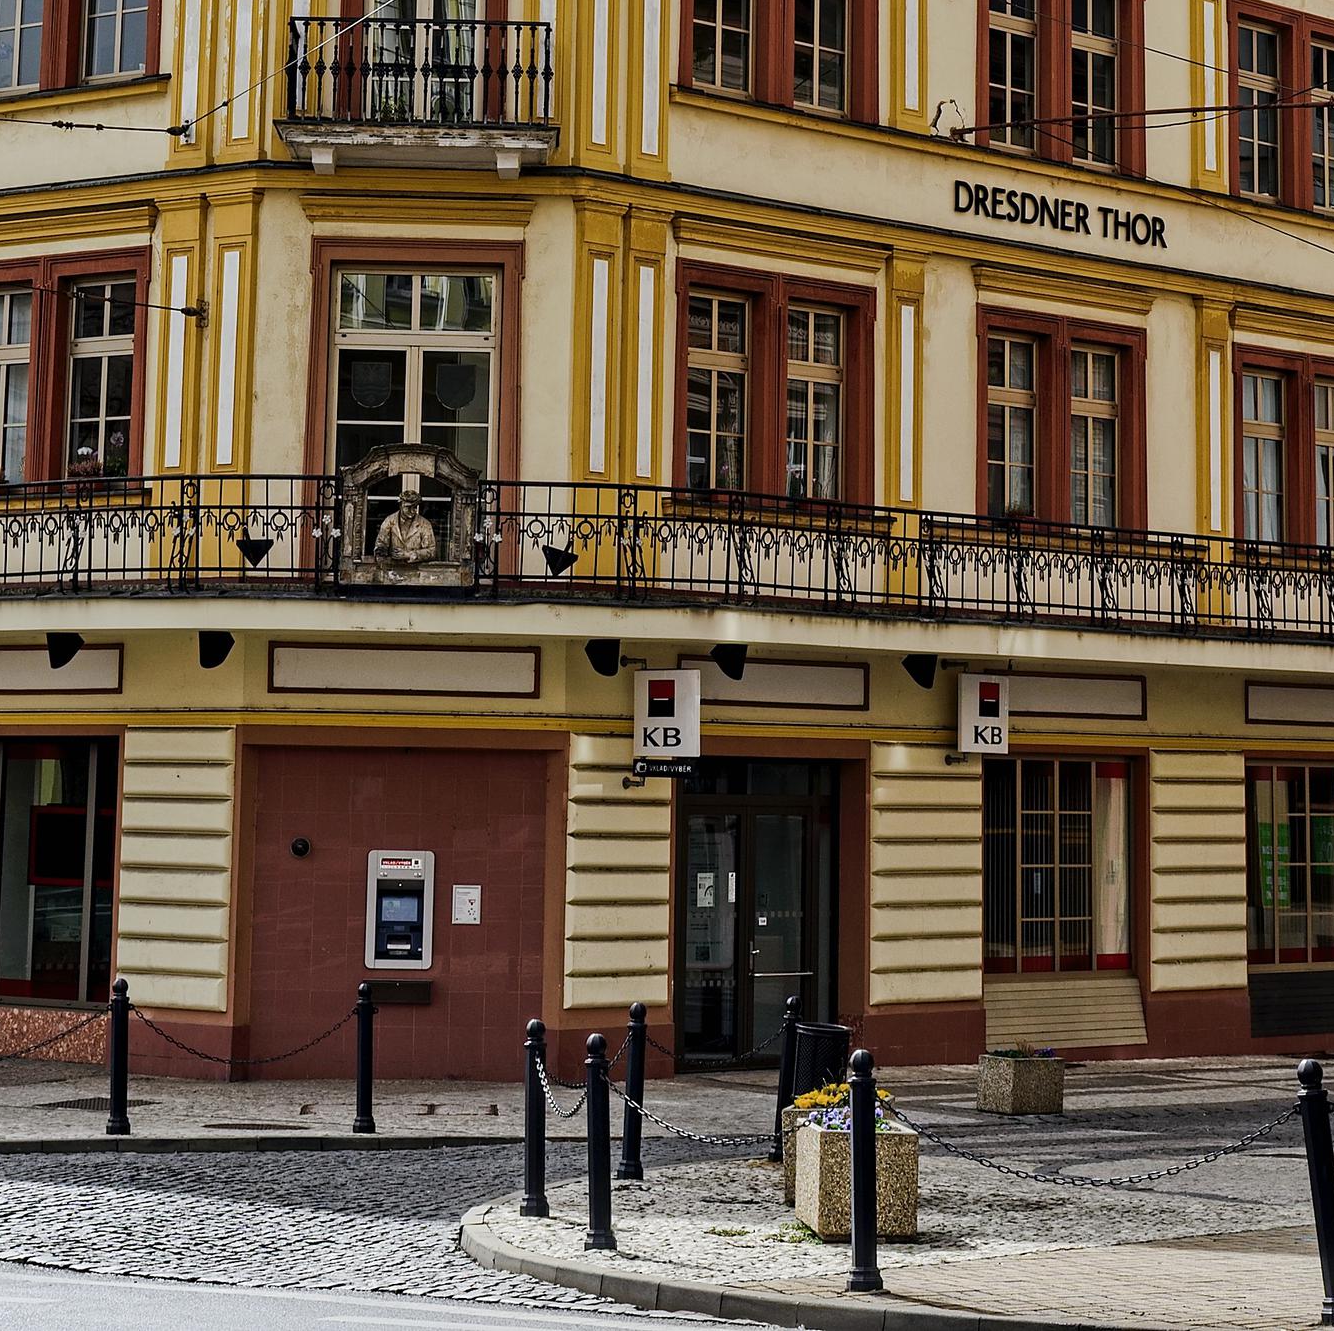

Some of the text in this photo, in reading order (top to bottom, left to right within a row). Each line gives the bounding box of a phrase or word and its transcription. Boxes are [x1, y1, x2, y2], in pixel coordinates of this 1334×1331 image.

[954, 179, 1167, 249] DRESDNER THOR
[643, 726, 682, 747] KB
[973, 725, 1003, 745] KB
